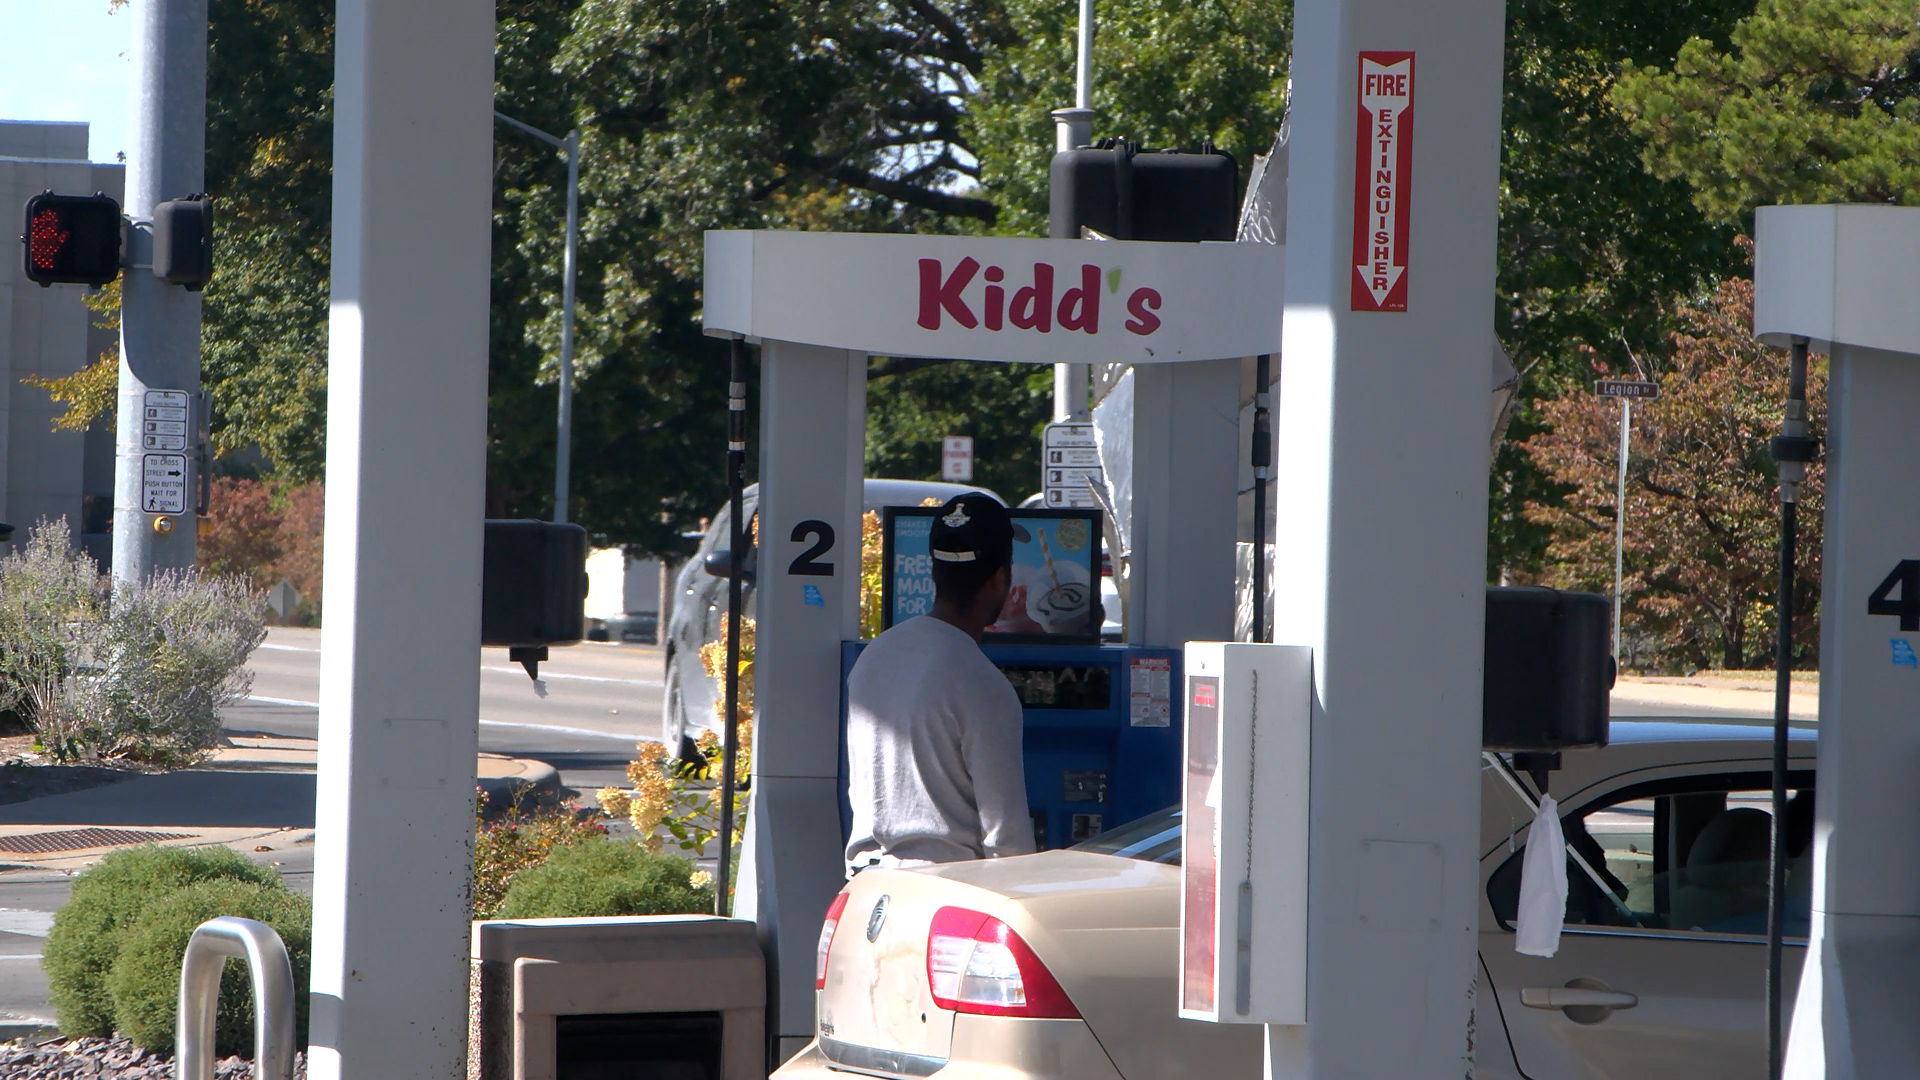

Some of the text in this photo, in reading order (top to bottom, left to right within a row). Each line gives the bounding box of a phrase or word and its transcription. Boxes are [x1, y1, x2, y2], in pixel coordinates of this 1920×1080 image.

[1365, 74, 1407, 97] FIRE
[1372, 109, 1393, 291] EXTINGUISHER
[917, 256, 1162, 336] Kidd's
[1604, 382, 1640, 396] Legion
[895, 529, 930, 537] SMOOTH
[788, 519, 835, 577] 2
[894, 554, 934, 576] FRES
[897, 577, 936, 595] MAD
[1867, 559, 1920, 631] 4
[897, 596, 927, 615] FOR
